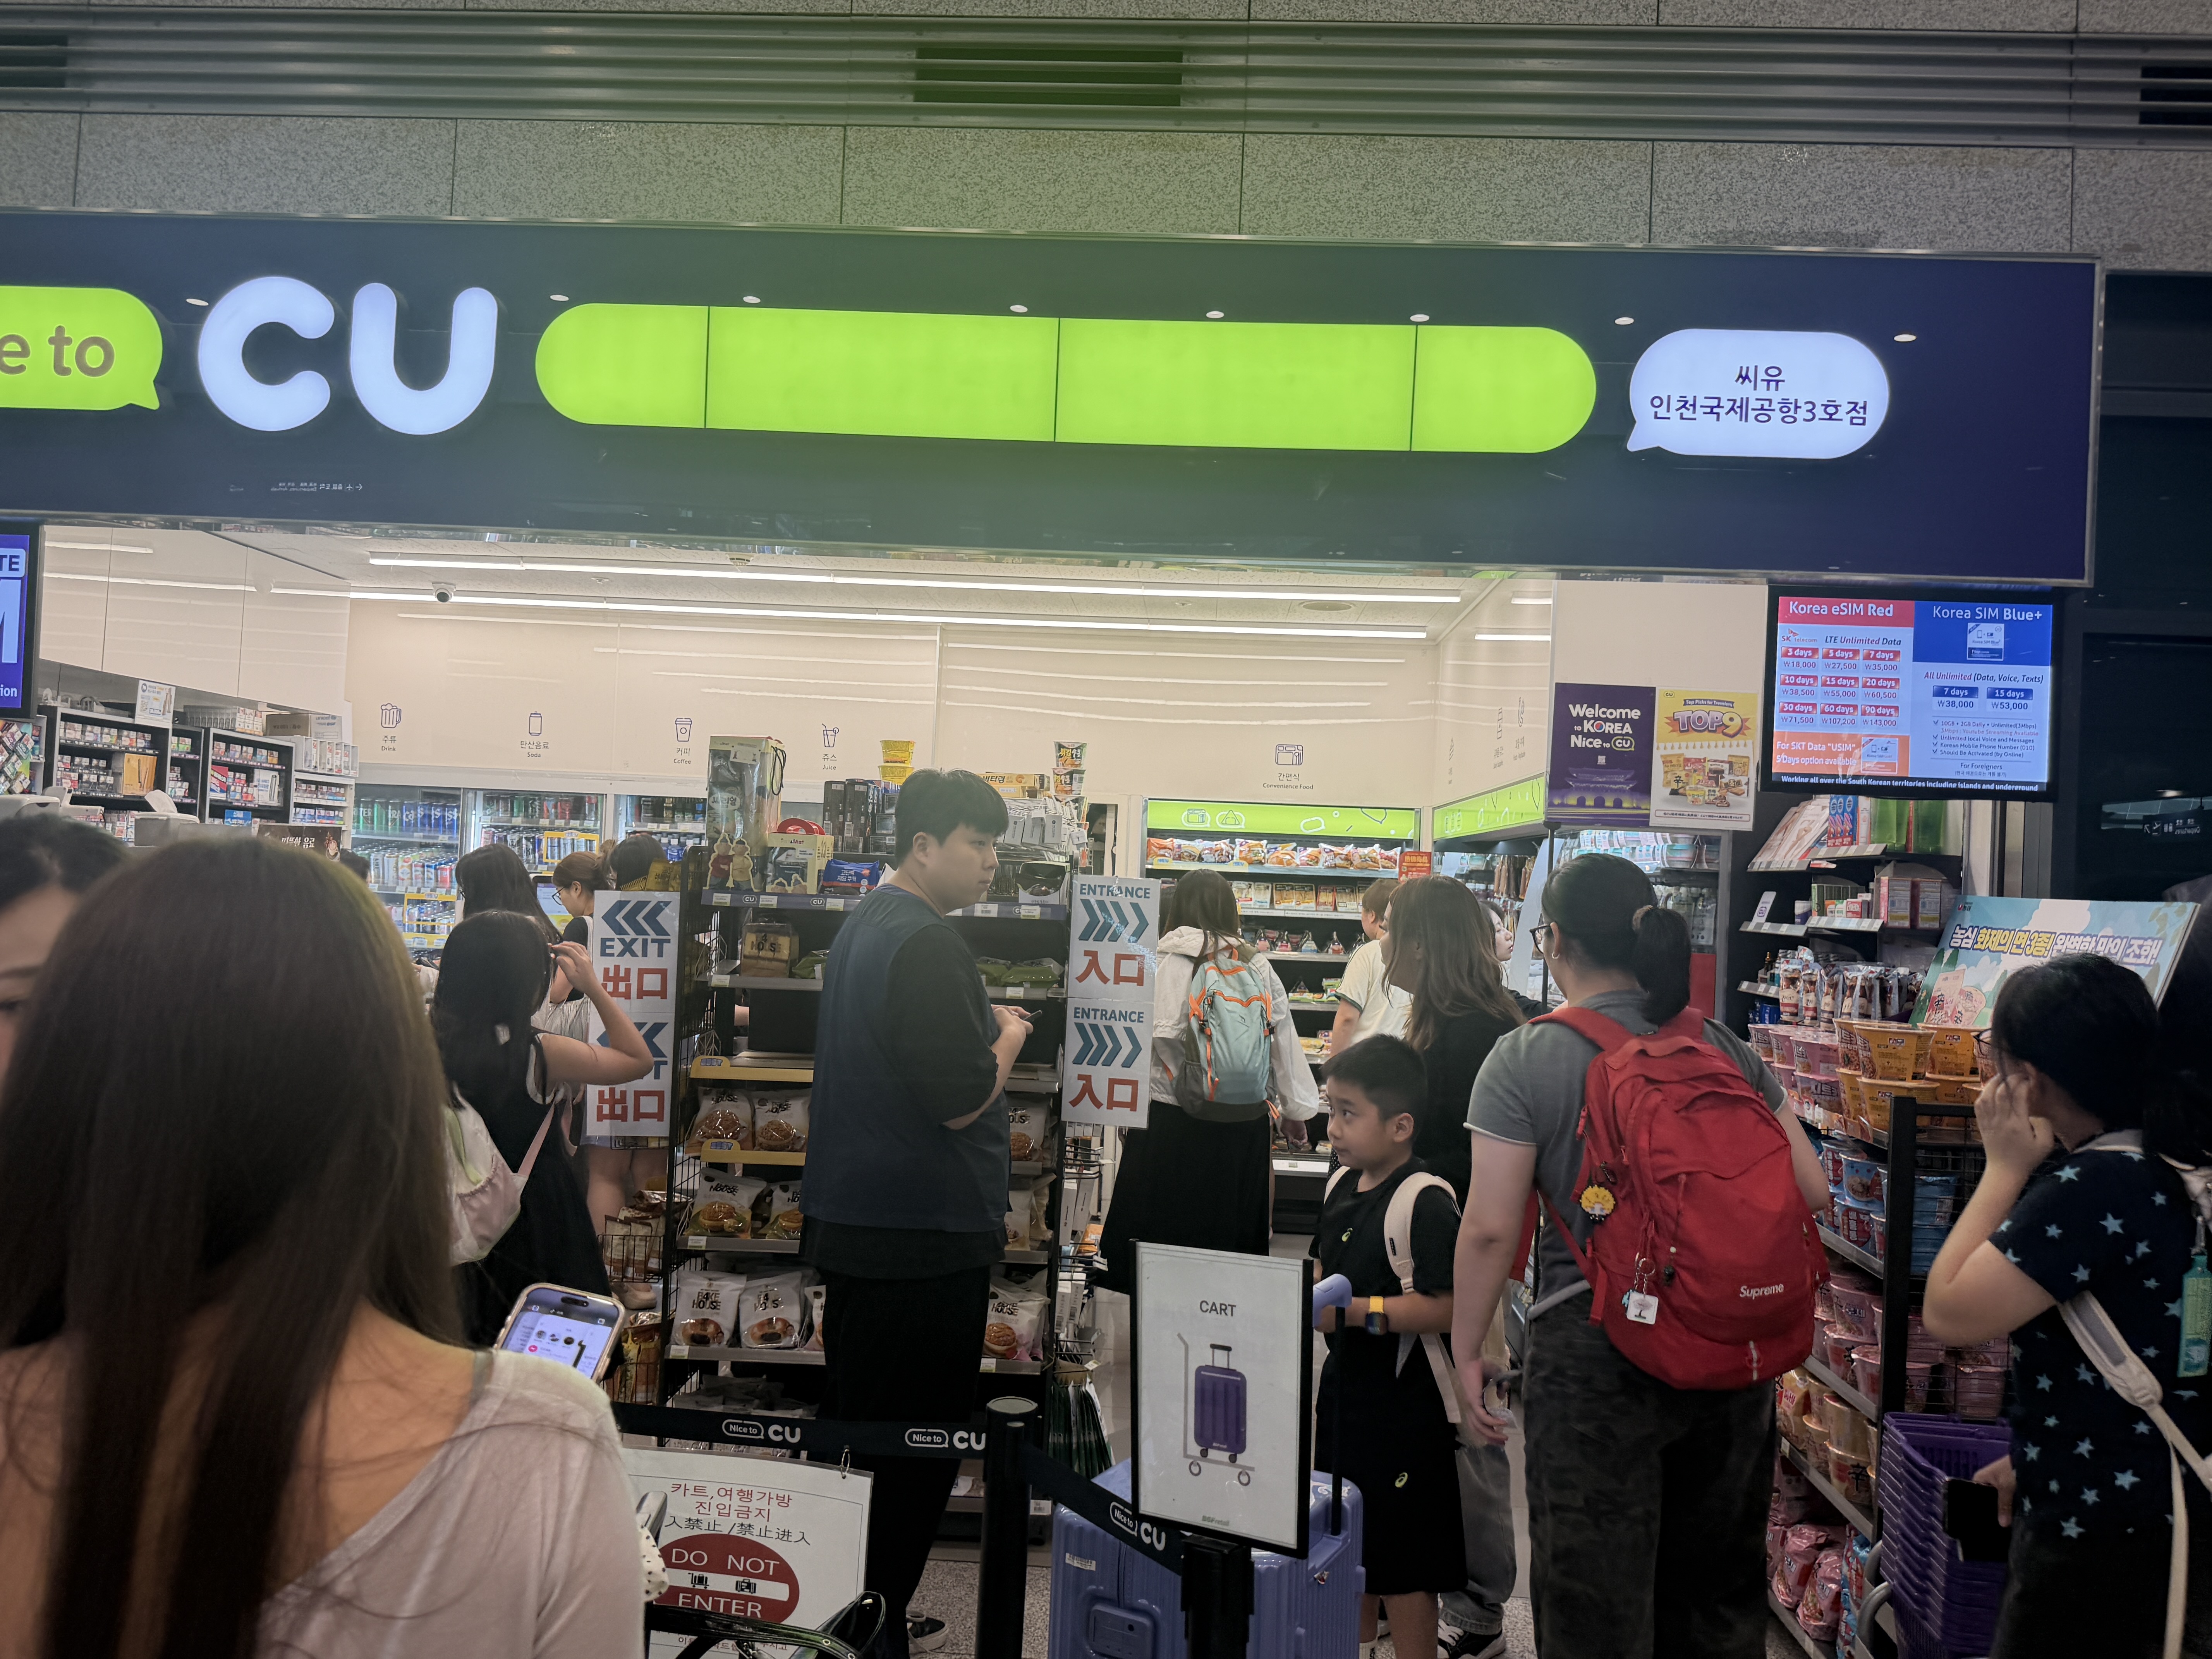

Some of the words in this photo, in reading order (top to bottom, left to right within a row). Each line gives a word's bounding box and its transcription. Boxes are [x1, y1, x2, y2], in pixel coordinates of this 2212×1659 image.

[48, 325, 115, 376] to
[198, 275, 498, 435] CU
[1735, 365, 1785, 391] 씨유
[1650, 395, 1868, 427] 인천국제공항3호점
[1790, 601, 1827, 615] Korea
[1832, 603, 1863, 615] eSIM
[1868, 603, 1893, 617] Red
[1933, 606, 1971, 619] Korea
[1975, 607, 1999, 620] SIM
[2003, 608, 2042, 621] Blue+
[1840, 636, 1880, 645] Unlimited
[1795, 649, 1812, 658] days
[1836, 650, 1853, 659] days
[1876, 651, 1893, 660] days
[1796, 676, 1814, 685] days
[1837, 678, 1855, 687] days
[1878, 679, 1895, 688] days
[1936, 672, 1972, 680] Unlimited
[1973, 673, 1996, 682] (Data,
[1999, 674, 2019, 683] Voice,
[2022, 675, 2043, 684] Texts)
[1951, 688, 1968, 697] days
[2006, 690, 2025, 699] days
[1569, 704, 1640, 720] Welcome
[1795, 704, 1813, 713] days
[1836, 705, 1853, 714] days
[1877, 706, 1894, 716] days
[1583, 720, 1632, 734] KOREA
[1673, 709, 1743, 737] TOP9
[383, 735, 397, 743] 주류
[520, 740, 549, 749] 탄산음료
[1571, 735, 1602, 748] Nice
[1616, 740, 1630, 748] CU
[1777, 741, 1789, 749] For
[1791, 742, 1805, 750] SKT
[1808, 742, 1826, 751] Data
[677, 747, 690, 756] 커피
[822, 753, 837, 762] 쥬스
[1801, 756, 1823, 766] option
[1825, 756, 1857, 766] available
[1278, 773, 1300, 781] 간편식
[1781, 775, 1809, 784] Working
[1892, 779, 1925, 787] territories
[1927, 780, 1957, 789] including
[1996, 783, 2038, 792] underground
[1080, 884, 1150, 899] ENTRANCE
[600, 938, 671, 958] EXIT
[1950, 926, 1978, 949] 농심
[1974, 927, 2014, 951] 화제의
[2011, 931, 2028, 954] 면
[2025, 933, 2054, 956] 3종!
[1075, 950, 1146, 986] 入口
[601, 965, 668, 1000] 出口
[1073, 1007, 1144, 1023] ENTRANCE
[1069, 1074, 1139, 1112] 入口
[596, 1087, 665, 1122] 出口
[697, 1291, 720, 1301] BAKE
[1740, 1284, 1784, 1299] Supreme
[692, 1300, 721, 1310] HOUSE
[1199, 1300, 1237, 1317] CART
[730, 1424, 747, 1434] Nice
[749, 1425, 757, 1435] to
[768, 1424, 801, 1443] CU
[912, 1433, 931, 1443] Nice
[932, 1434, 942, 1443] to
[952, 1430, 986, 1450] CU
[671, 1482, 793, 1508] 카트,여행가방
[695, 1501, 771, 1522] 진입금지
[1114, 1509, 1127, 1524] Nice
[1127, 1517, 1134, 1529] to
[1140, 1522, 1166, 1551] CU
[672, 1548, 708, 1566] DO
[728, 1554, 779, 1576] NOT
[678, 1593, 762, 1619] ENTER
